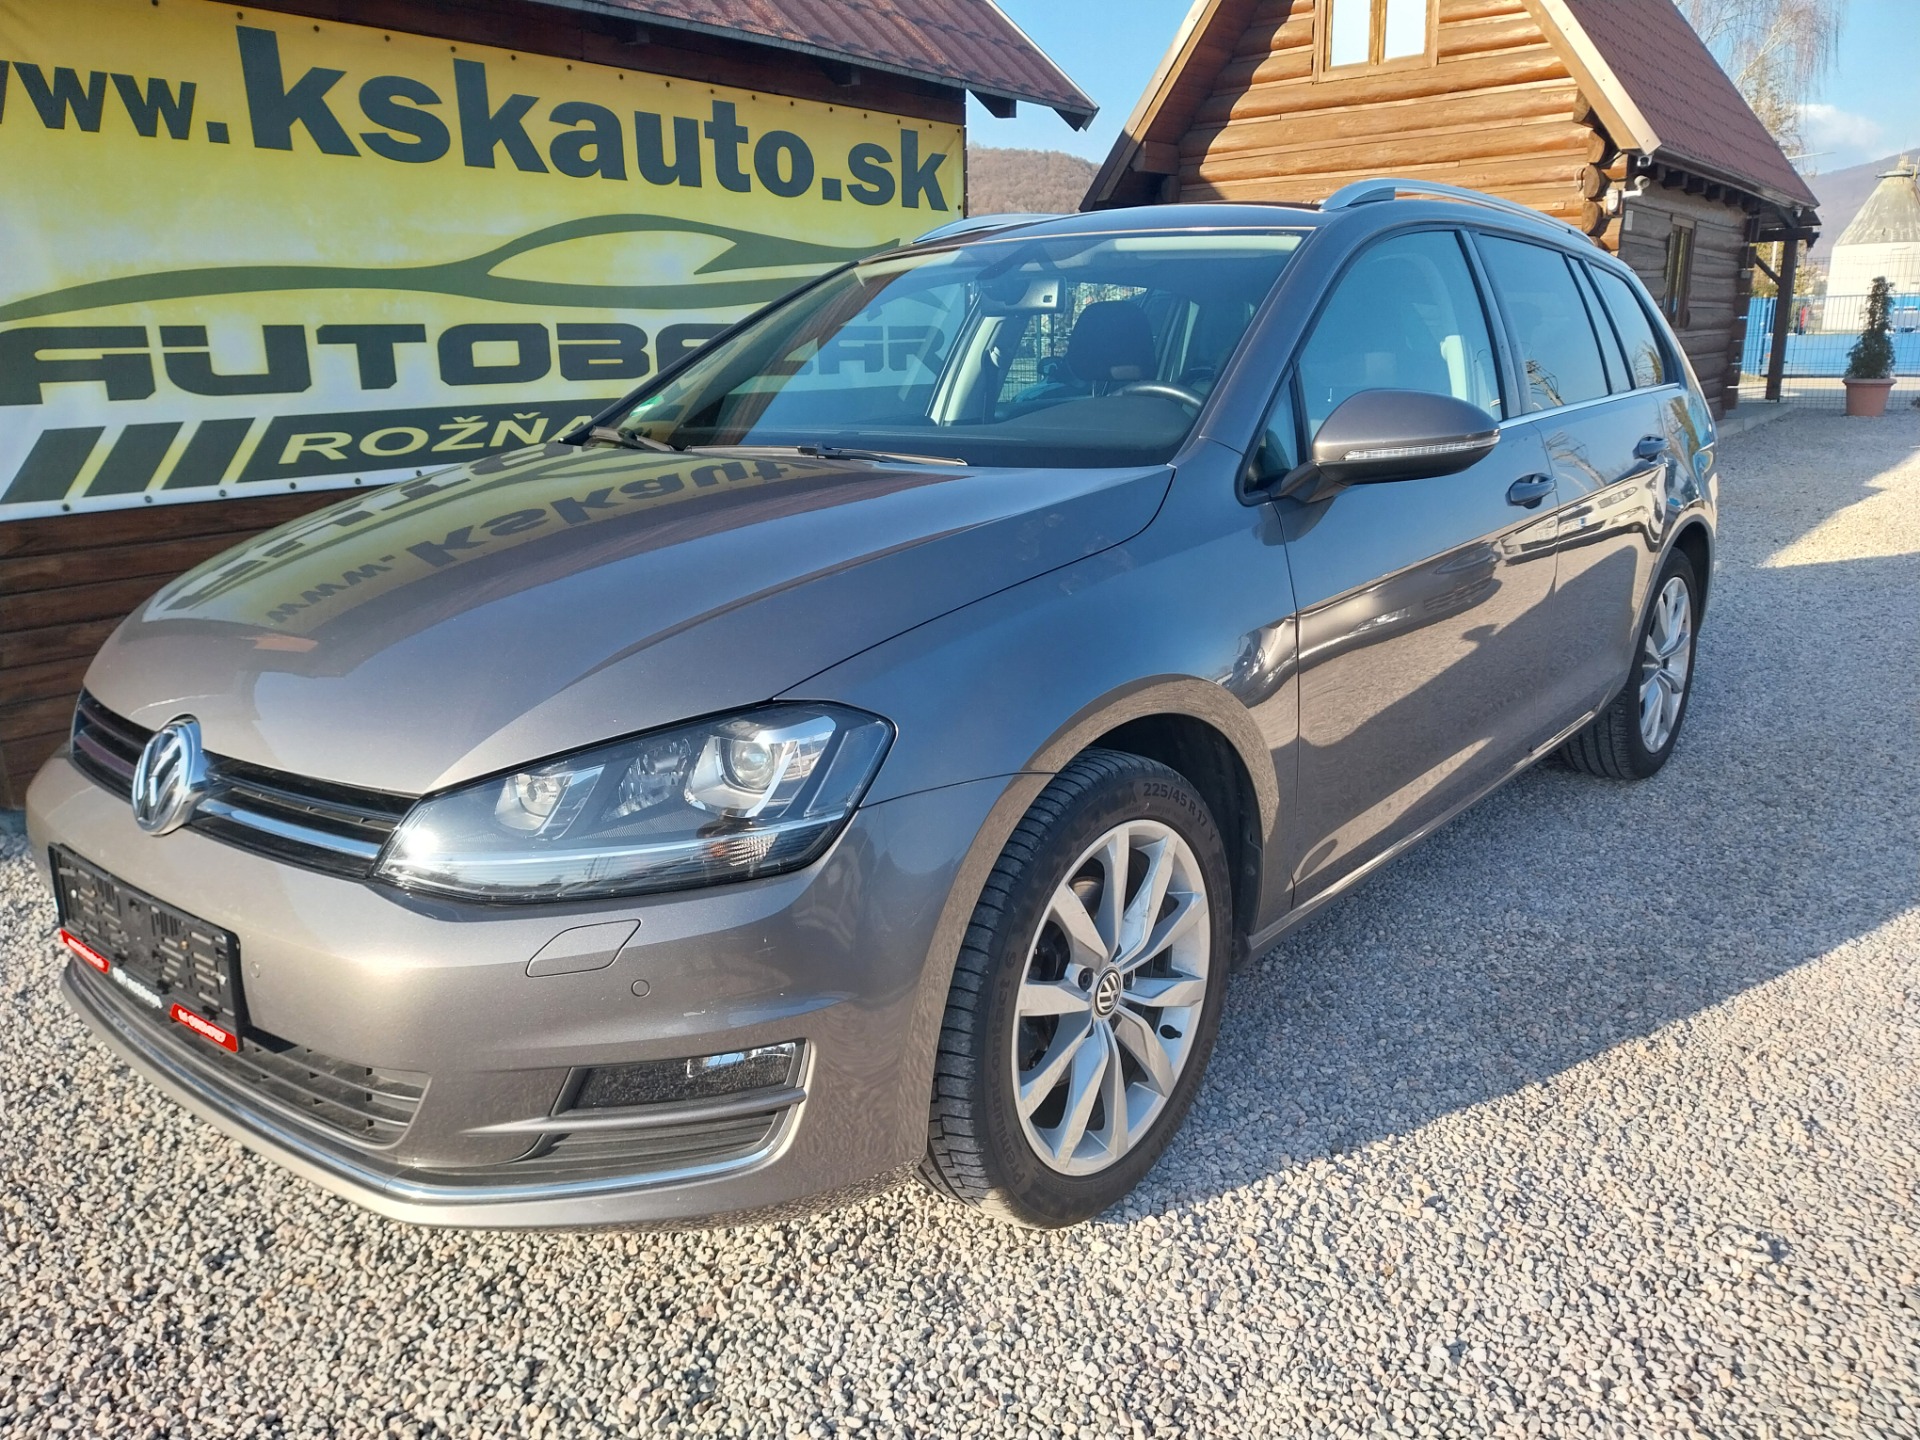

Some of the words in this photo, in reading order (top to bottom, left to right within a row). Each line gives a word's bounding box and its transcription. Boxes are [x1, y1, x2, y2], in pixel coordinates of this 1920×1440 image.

[0, 25, 949, 212] ww.kskauto.sk
[1143, 782, 1188, 807] 225/45
[1188, 801, 1197, 815] R
[1198, 809, 1208, 827] 17
[991, 979, 1026, 1188] PremiumContact
